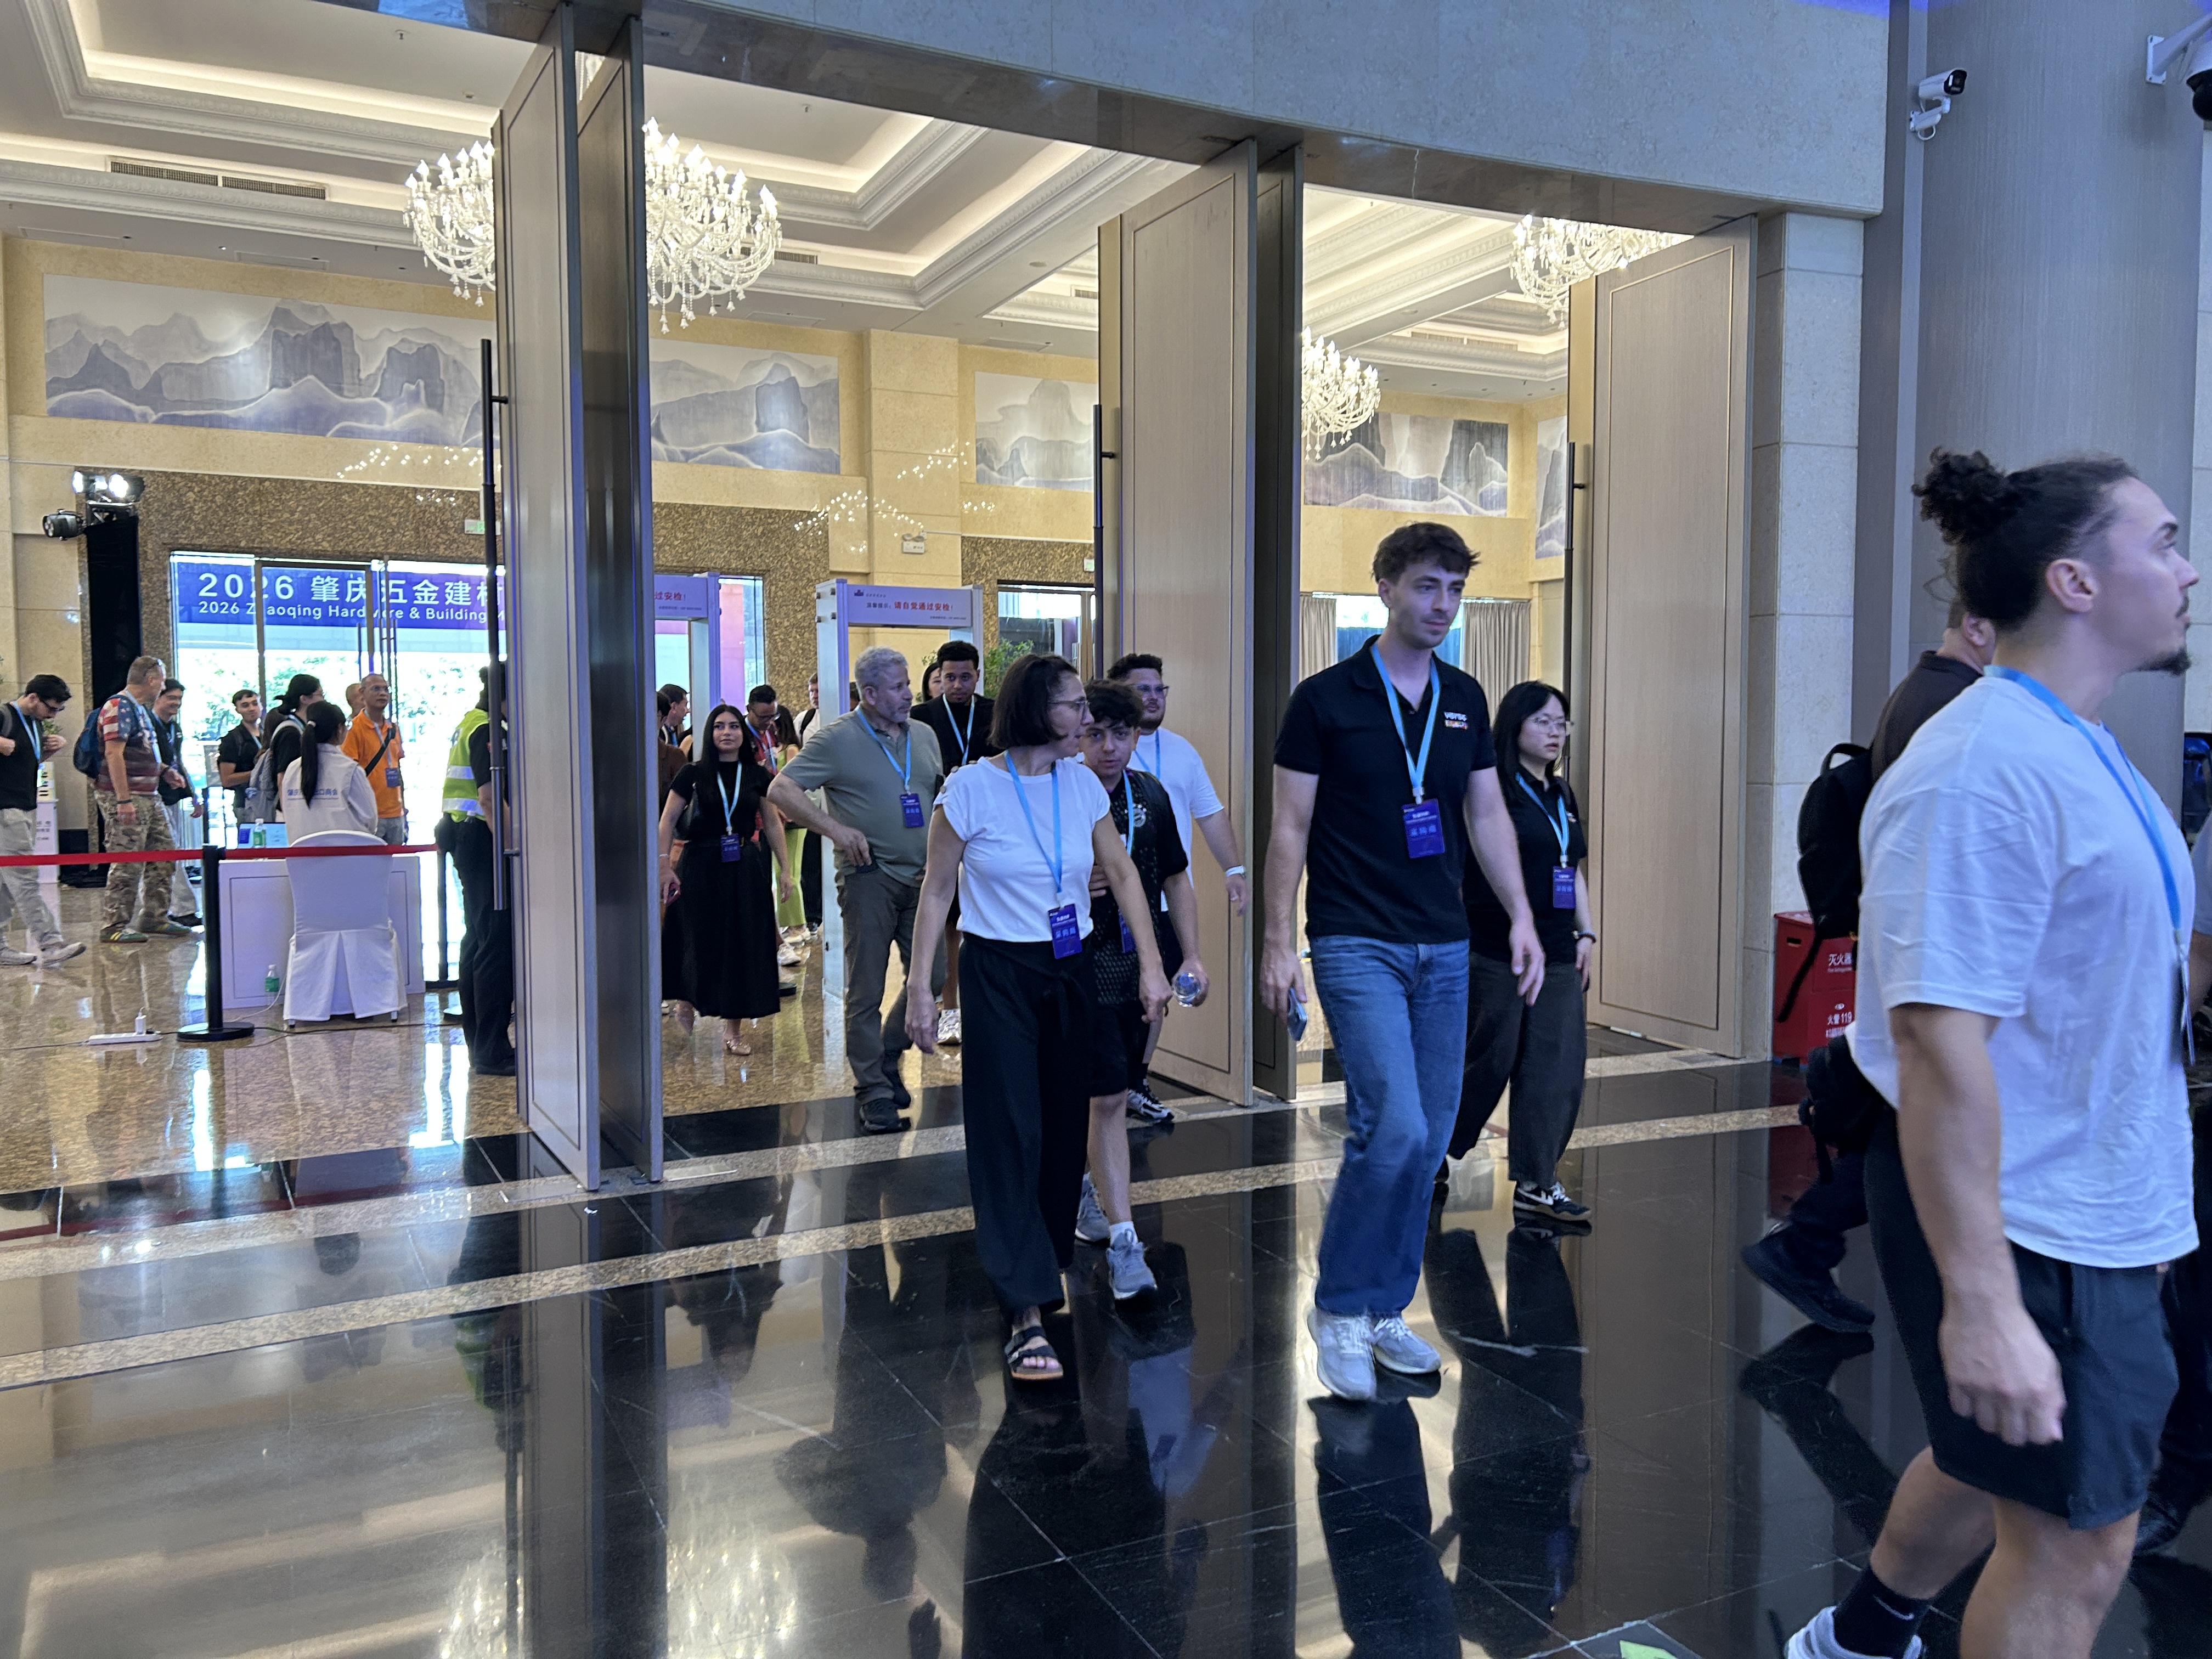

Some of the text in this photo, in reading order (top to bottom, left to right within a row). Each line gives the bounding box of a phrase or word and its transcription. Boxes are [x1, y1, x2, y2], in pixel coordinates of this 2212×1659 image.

[199, 573, 294, 600] 2026
[198, 601, 240, 614] 2026
[246, 602, 321, 620] Zaoqing
[409, 607, 420, 619] &
[426, 608, 487, 623] Building
